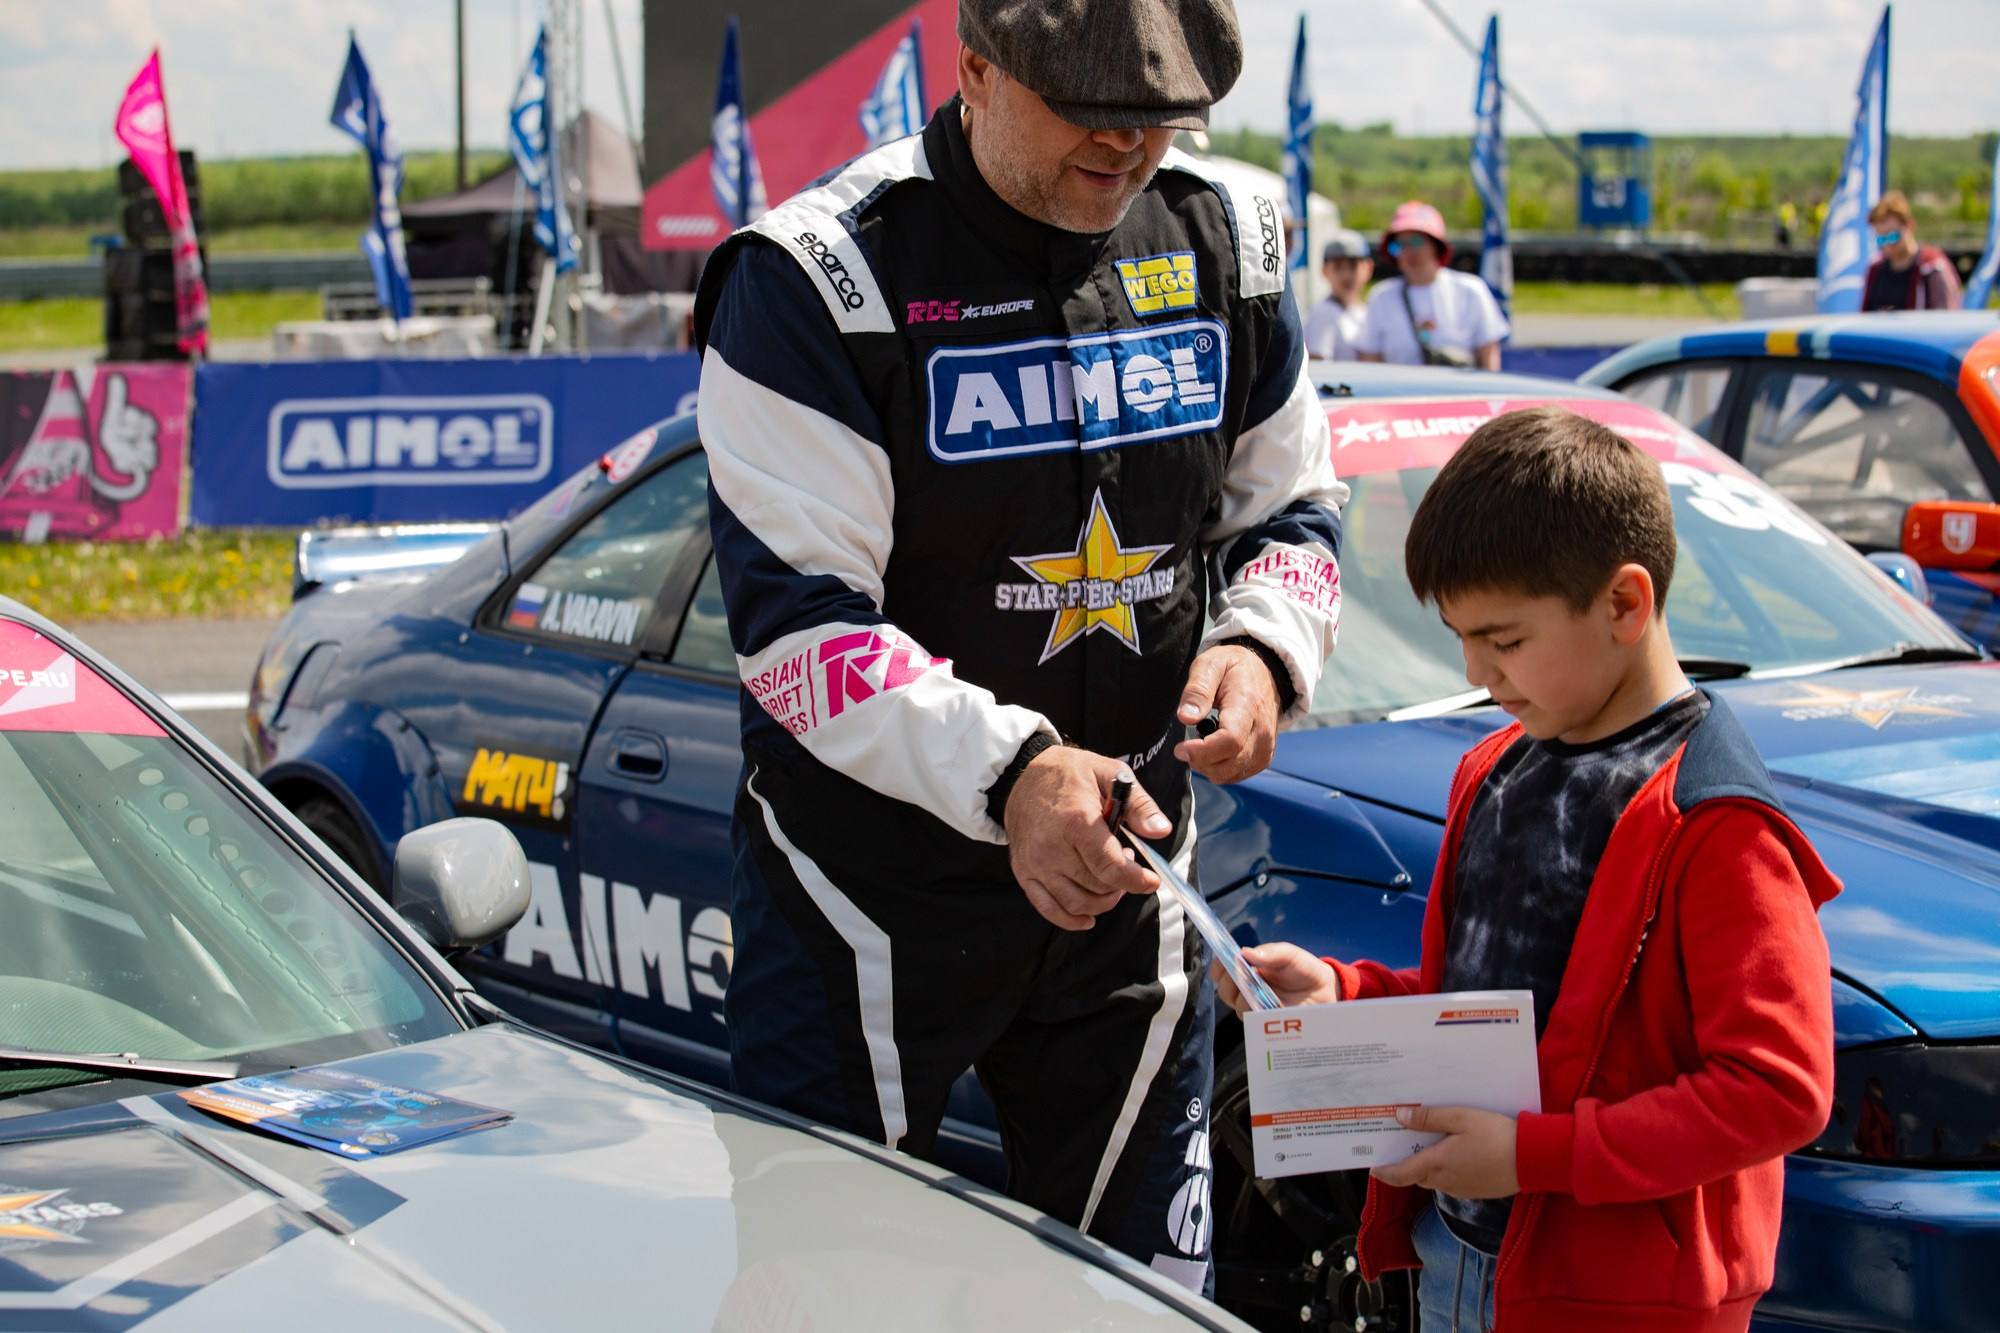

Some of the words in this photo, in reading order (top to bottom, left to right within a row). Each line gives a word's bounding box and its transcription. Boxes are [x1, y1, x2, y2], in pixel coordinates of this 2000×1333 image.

[1253, 195, 1280, 274] sparco
[797, 232, 864, 311] sparco
[1125, 270, 1195, 299] WEGO
[981, 300, 1034, 316] EUROPE
[1391, 416, 1492, 438] EURO
[996, 583, 1059, 612] STAR
[743, 653, 804, 699] USSIAN
[503, 860, 734, 1025] AIMO
[1264, 1019, 1302, 1034] CR
